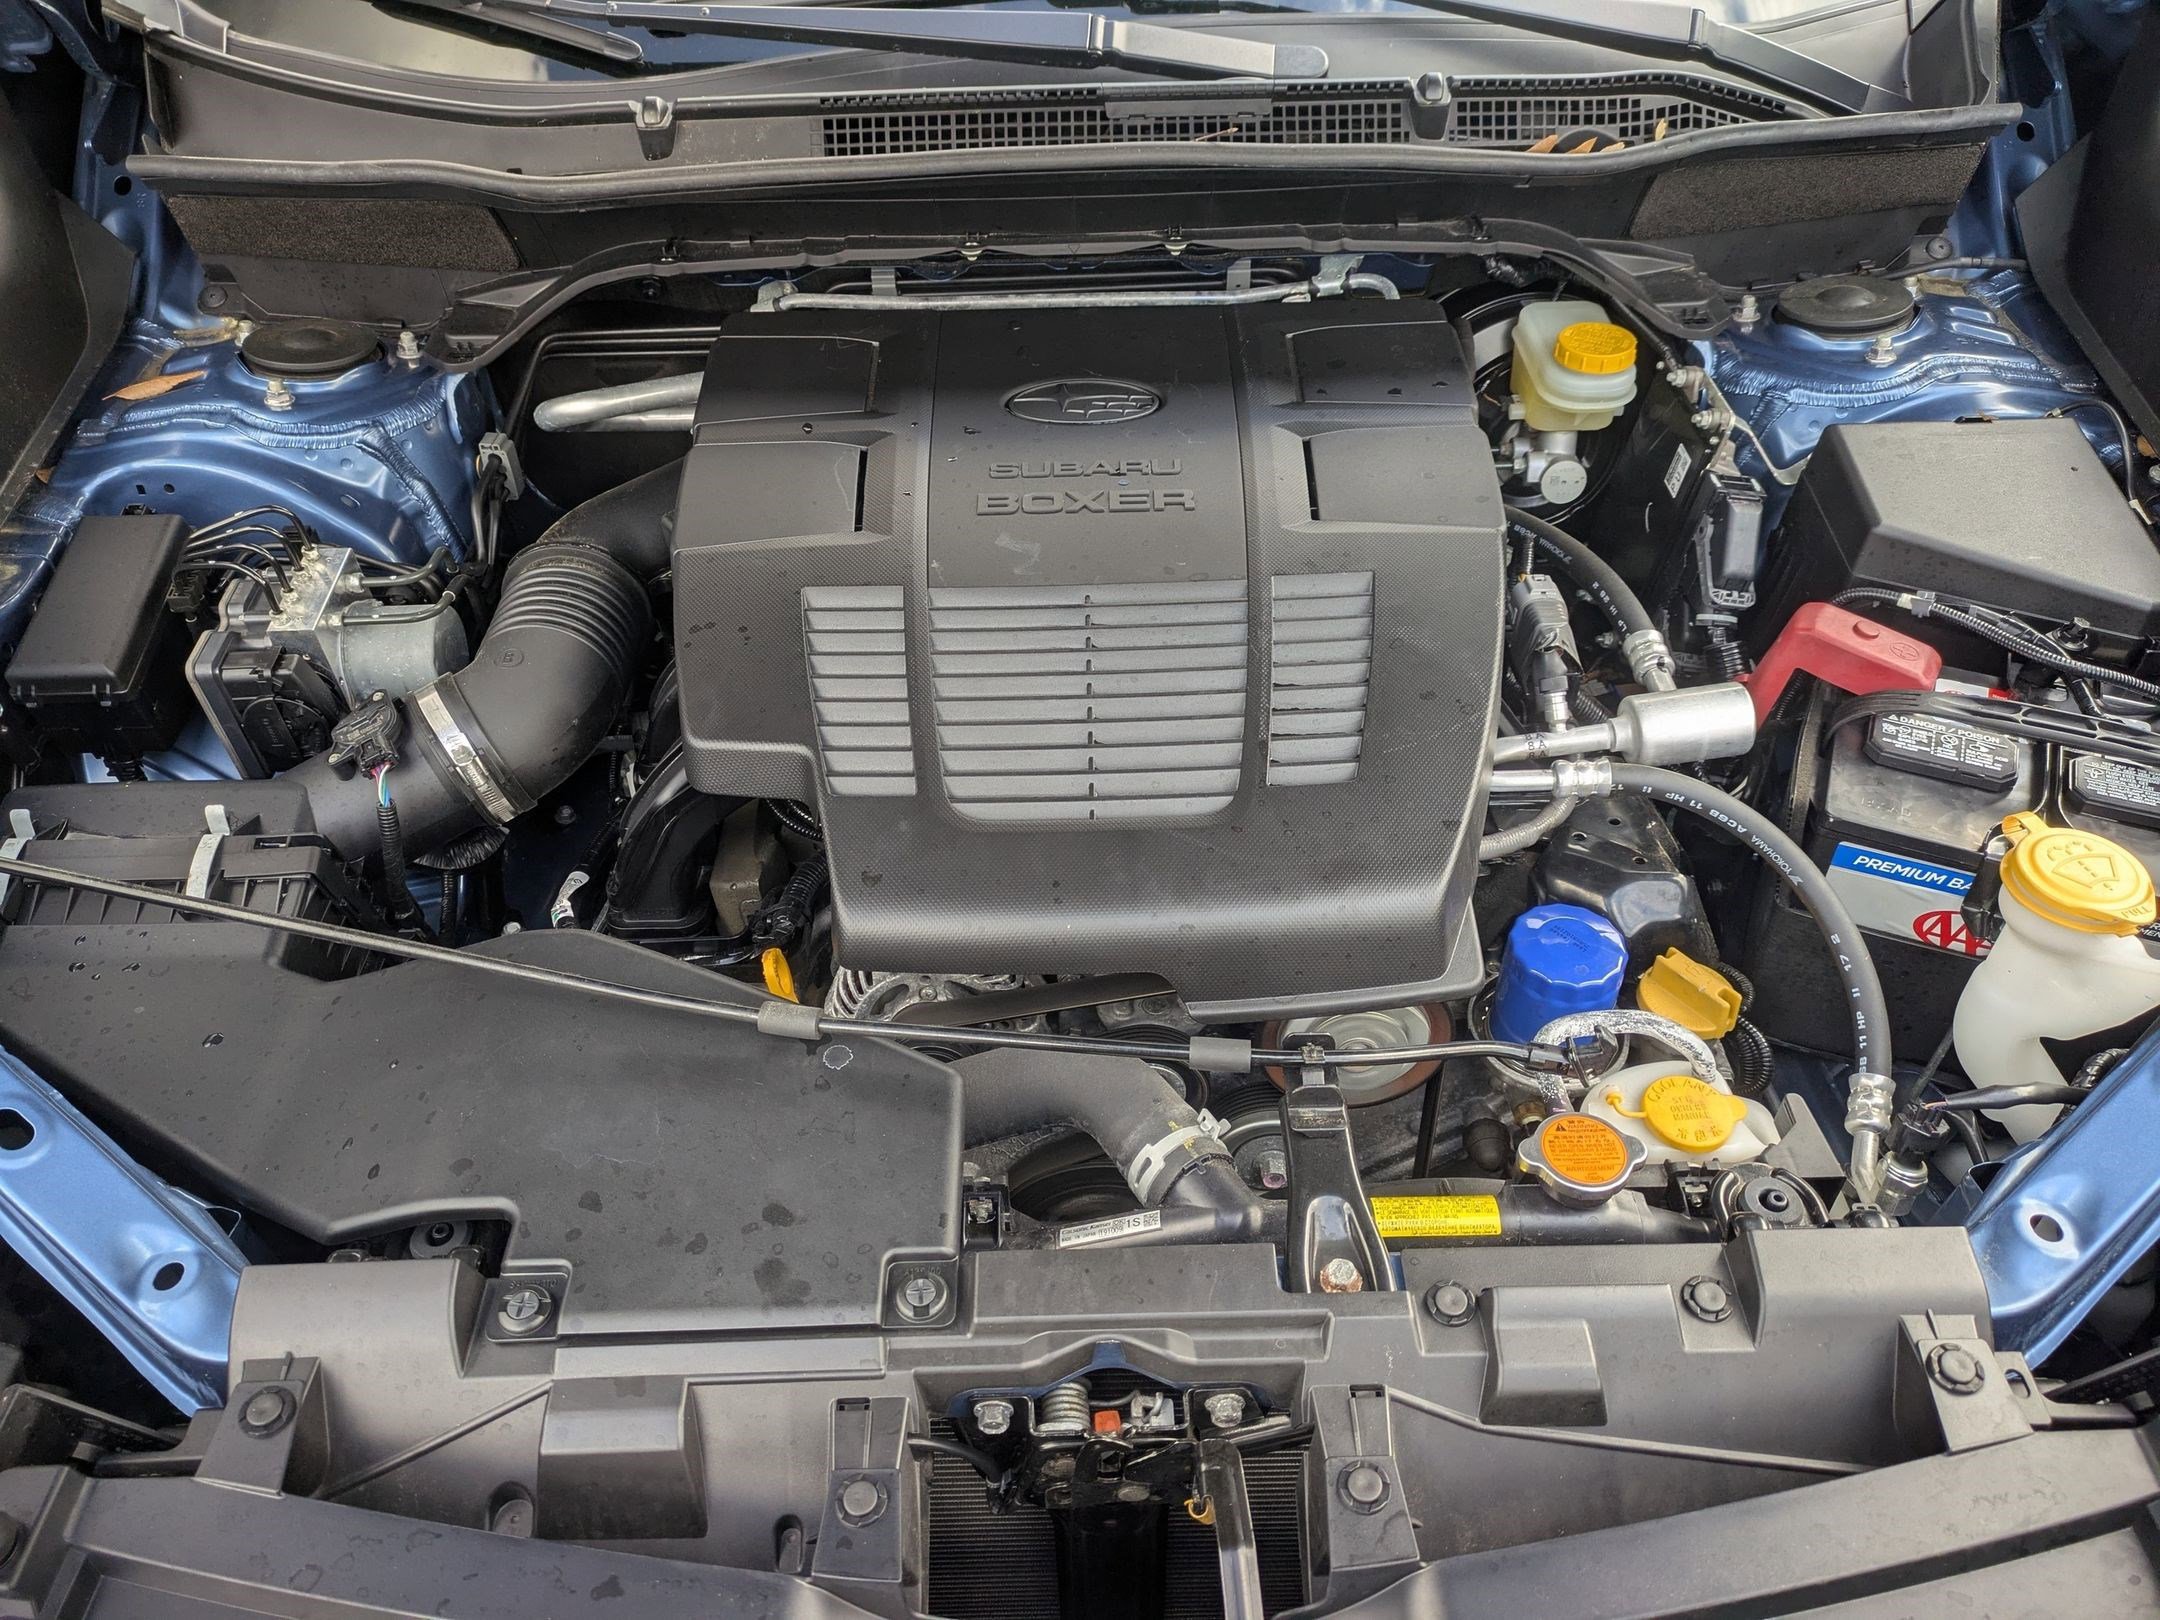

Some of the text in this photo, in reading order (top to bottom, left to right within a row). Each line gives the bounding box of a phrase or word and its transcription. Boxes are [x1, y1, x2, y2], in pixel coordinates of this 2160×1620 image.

[989, 458, 1183, 479] SUBARU
[976, 488, 1195, 516] BOXER
[1900, 716, 1947, 732] DANGER
[1958, 729, 2000, 744] POISON
[1665, 792, 1686, 803] HP
[1689, 801, 1705, 810] 11
[1752, 834, 1793, 874] YOKOHAMA
[1853, 855, 1948, 884] PREMIUM
[1856, 1011, 1866, 1030] HP
[1126, 1217, 1141, 1229] 1S
